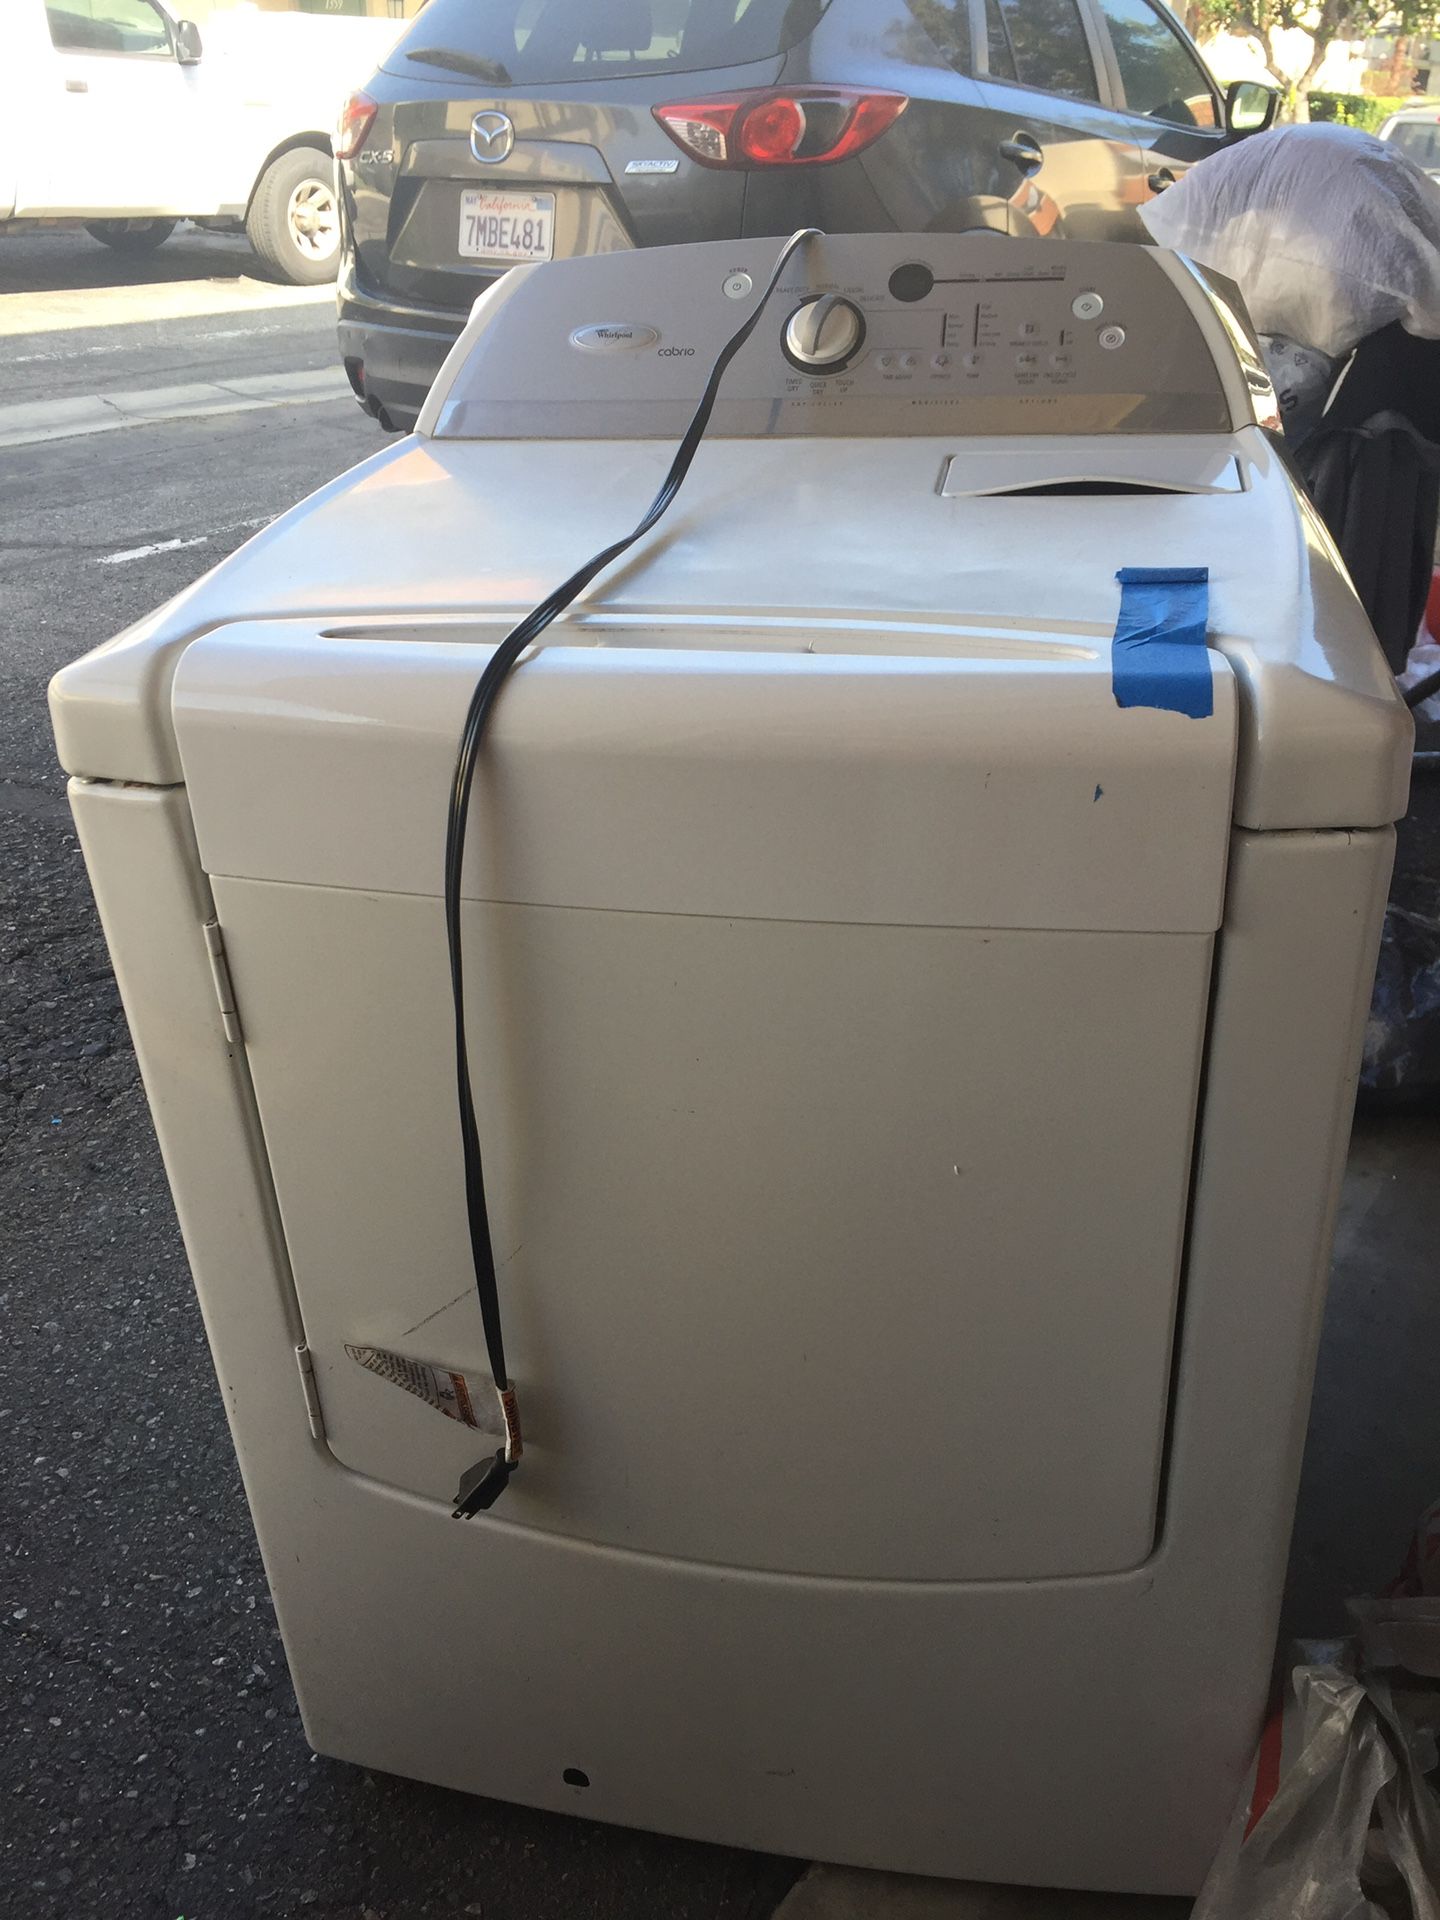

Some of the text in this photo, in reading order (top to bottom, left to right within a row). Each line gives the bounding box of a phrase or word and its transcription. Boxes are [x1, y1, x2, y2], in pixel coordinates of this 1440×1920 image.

[359, 150, 393, 164] CX-5
[479, 195, 536, 215] California
[466, 214, 545, 251] 7MBE481
[597, 331, 633, 340] Whirlpool
[657, 346, 695, 357] cabrio
